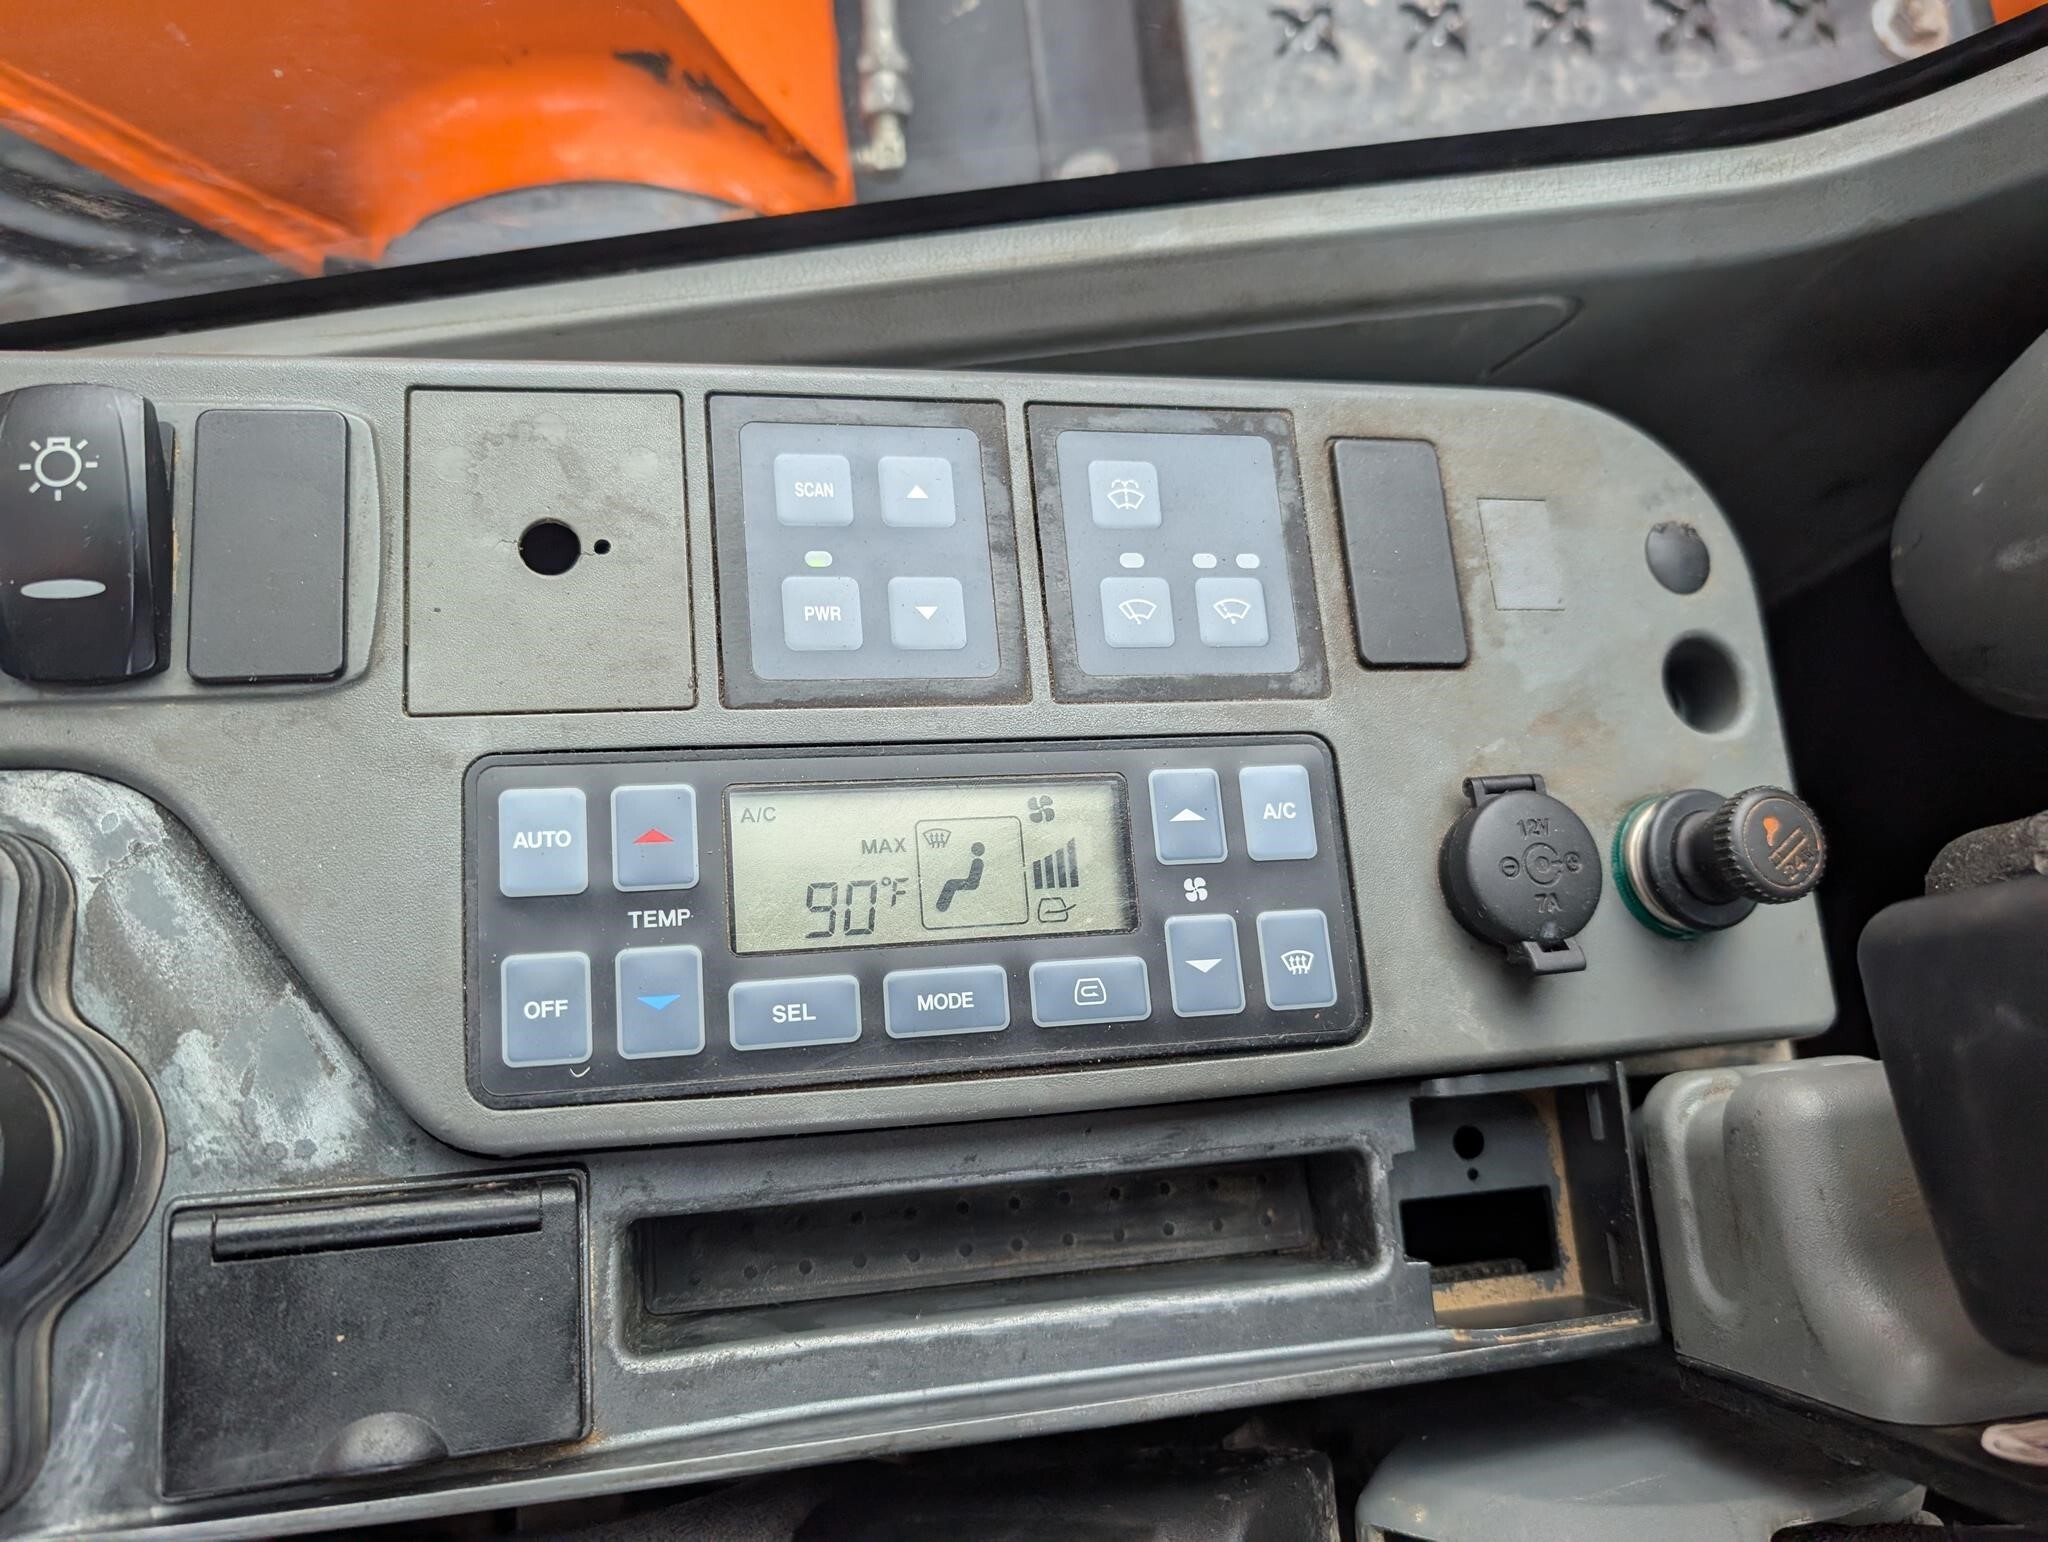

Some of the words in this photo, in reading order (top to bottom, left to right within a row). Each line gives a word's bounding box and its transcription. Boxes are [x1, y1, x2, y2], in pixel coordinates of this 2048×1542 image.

[795, 482, 834, 498] SCAN
[804, 606, 841, 621] PWR
[741, 807, 776, 823] A/C
[1264, 803, 1296, 820] A/C
[513, 830, 571, 848] AUTO
[861, 838, 906, 855] MAX
[628, 909, 691, 928] TEMP
[523, 1000, 568, 1018] OFF
[917, 992, 974, 1011] MODE
[772, 1004, 816, 1022] SEL
